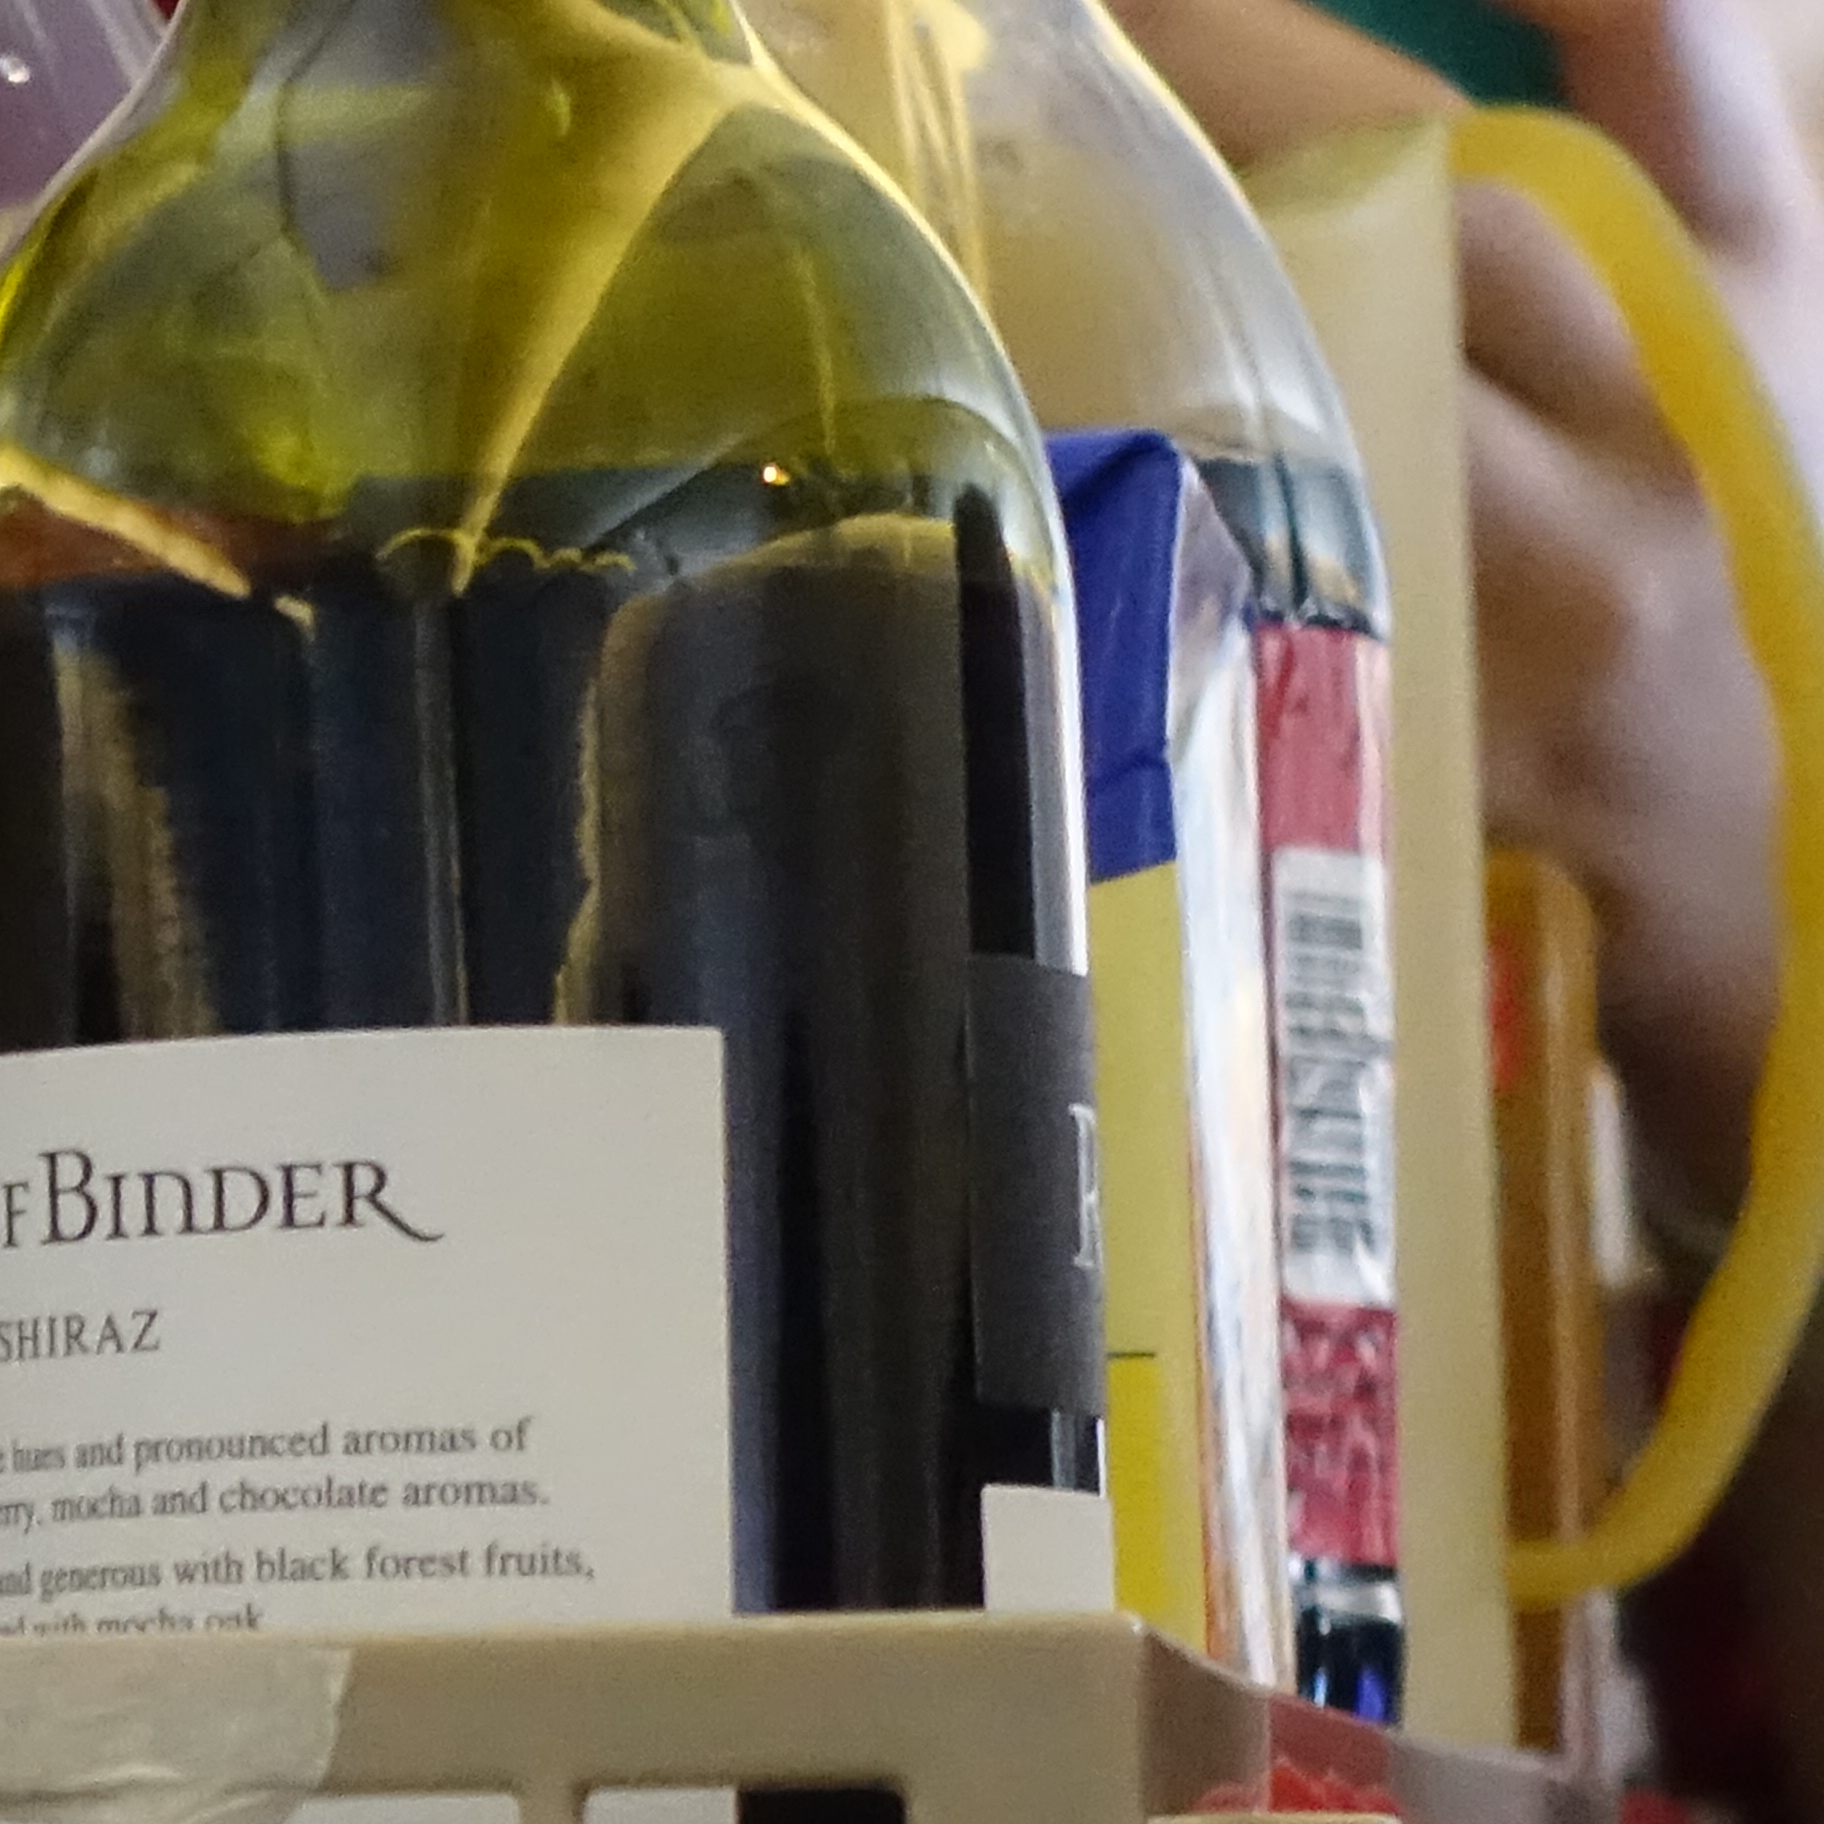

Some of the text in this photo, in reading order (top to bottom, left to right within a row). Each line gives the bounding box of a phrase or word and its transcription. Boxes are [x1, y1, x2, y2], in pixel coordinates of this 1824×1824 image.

[75, 1432, 124, 1468] and
[134, 1421, 329, 1476] pronounced
[342, 1426, 477, 1456] aromas
[489, 1415, 533, 1451] of
[51, 1484, 142, 1521] mocha
[153, 1482, 207, 1514] and
[219, 1475, 389, 1514] chocolate
[402, 1479, 550, 1508] aromas.
[41, 1563, 160, 1603] generous
[173, 1550, 243, 1585] with
[256, 1546, 350, 1582] black
[365, 1545, 470, 1579] forest
[484, 1540, 595, 1582] fruits,
